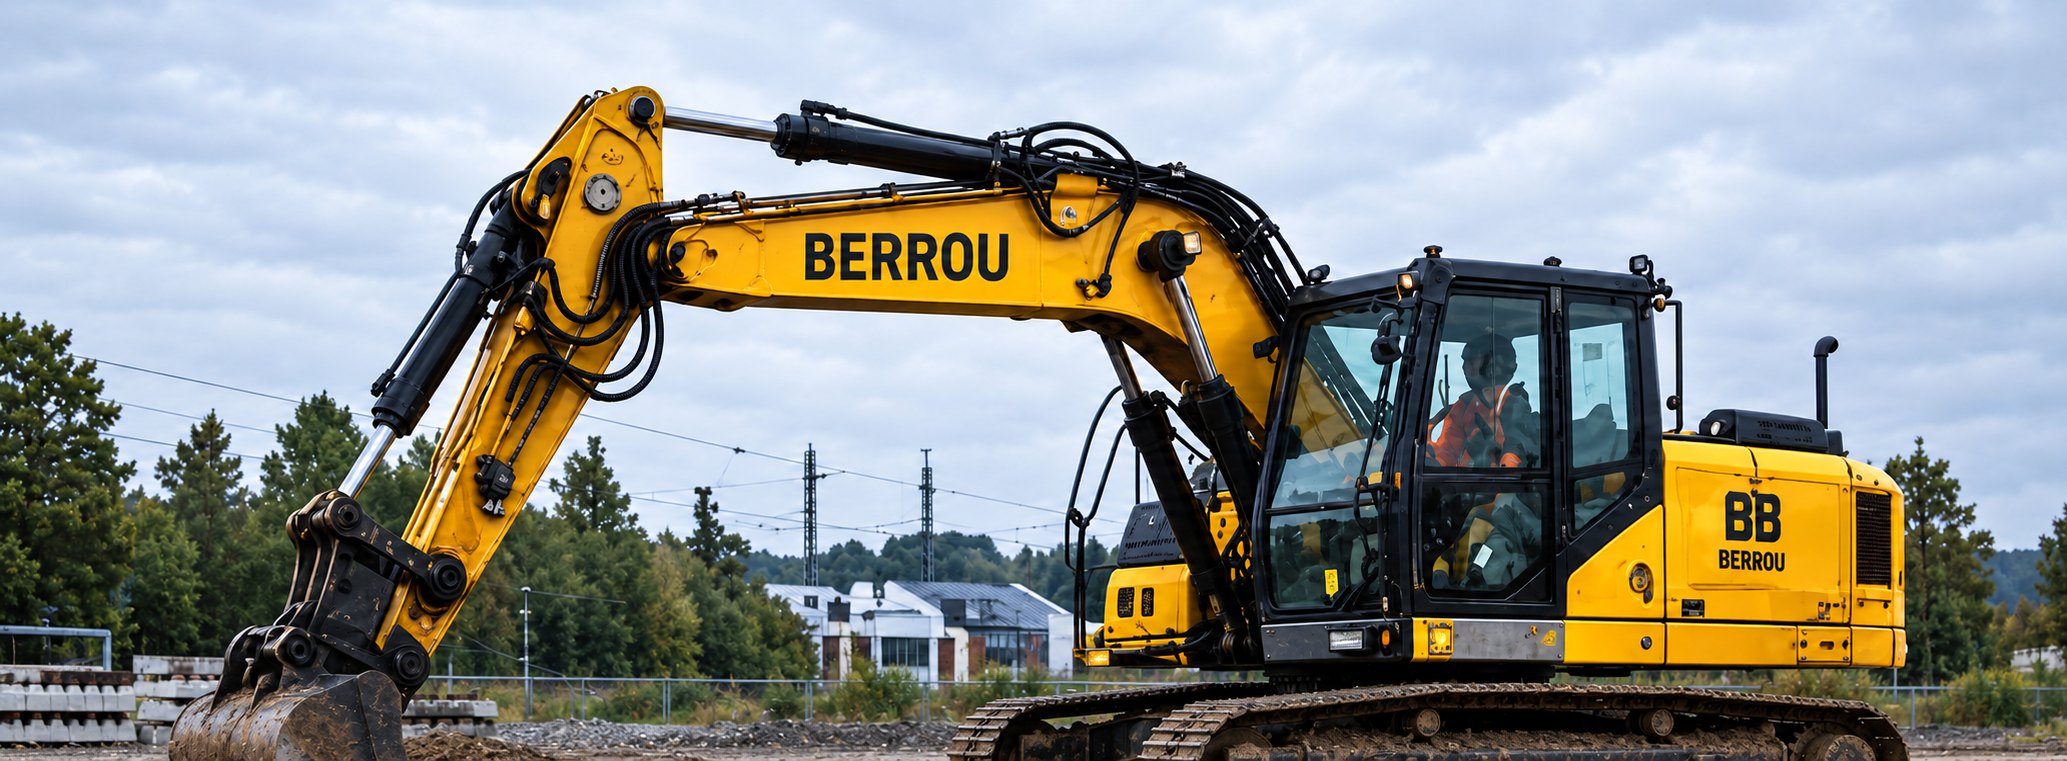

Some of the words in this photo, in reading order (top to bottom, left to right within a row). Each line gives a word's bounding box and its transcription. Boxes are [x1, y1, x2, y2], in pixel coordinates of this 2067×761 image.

[805, 232, 1009, 281] BERROU
[1725, 491, 1781, 542] BB
[1719, 549, 1785, 571] BERROU
